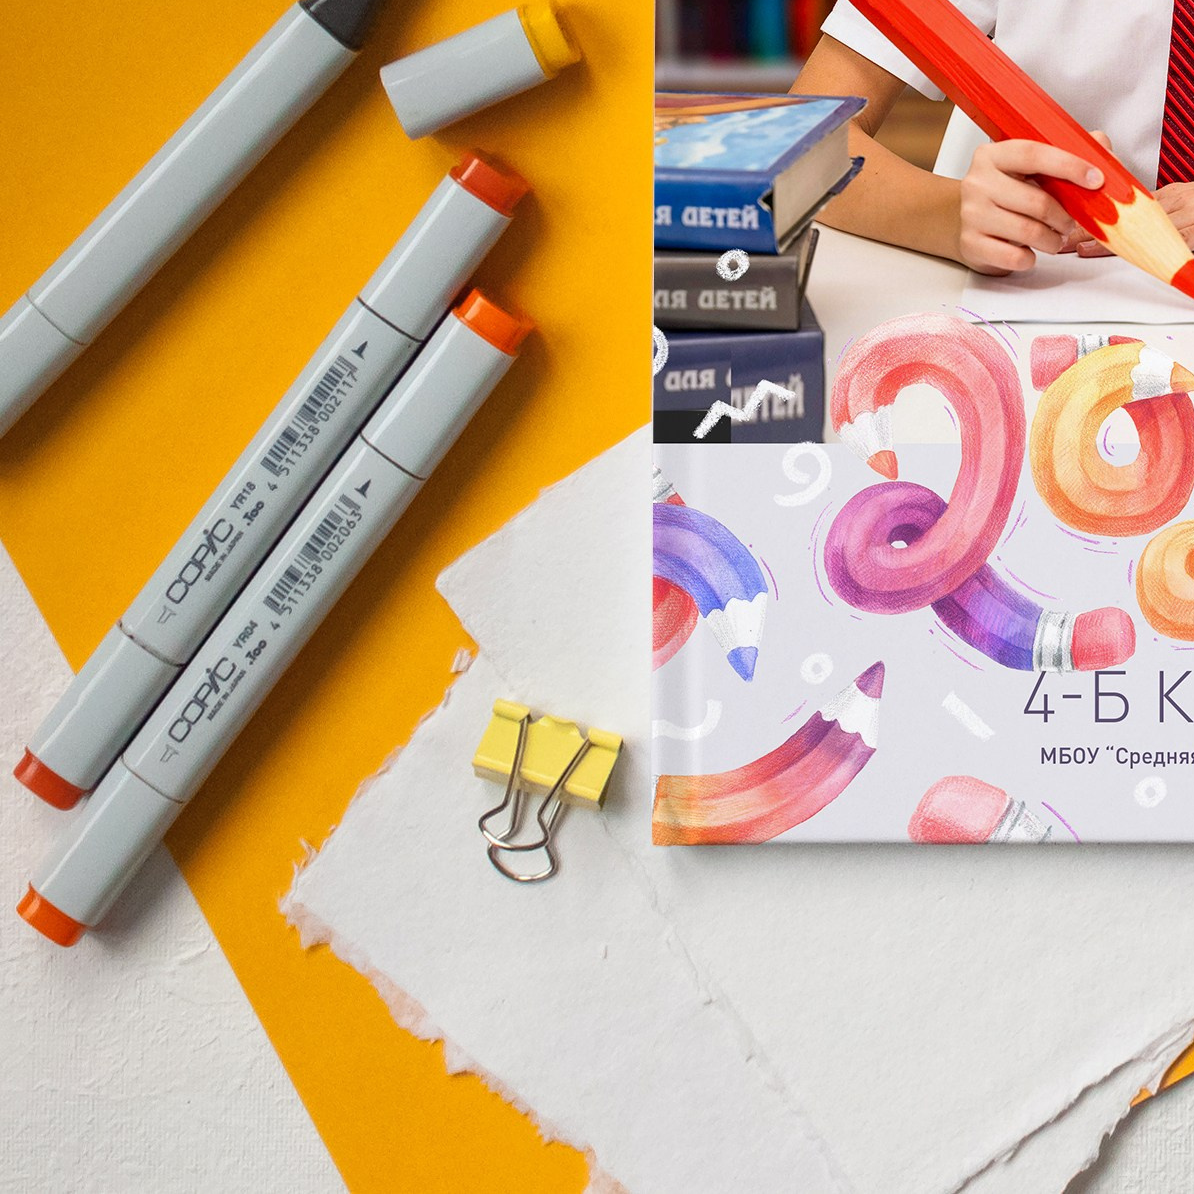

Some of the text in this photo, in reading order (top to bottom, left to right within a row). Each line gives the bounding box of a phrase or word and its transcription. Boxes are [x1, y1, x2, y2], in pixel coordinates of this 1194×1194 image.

[278, 424, 320, 477] 511338
[230, 481, 256, 510] YR18
[165, 518, 234, 604] COPIC
[281, 563, 323, 615] 511338
[232, 620, 258, 650] YR04
[168, 656, 237, 744] COPIC
[1023, 670, 1130, 724] 4-Б
[1040, 747, 1099, 766] МБОУ
